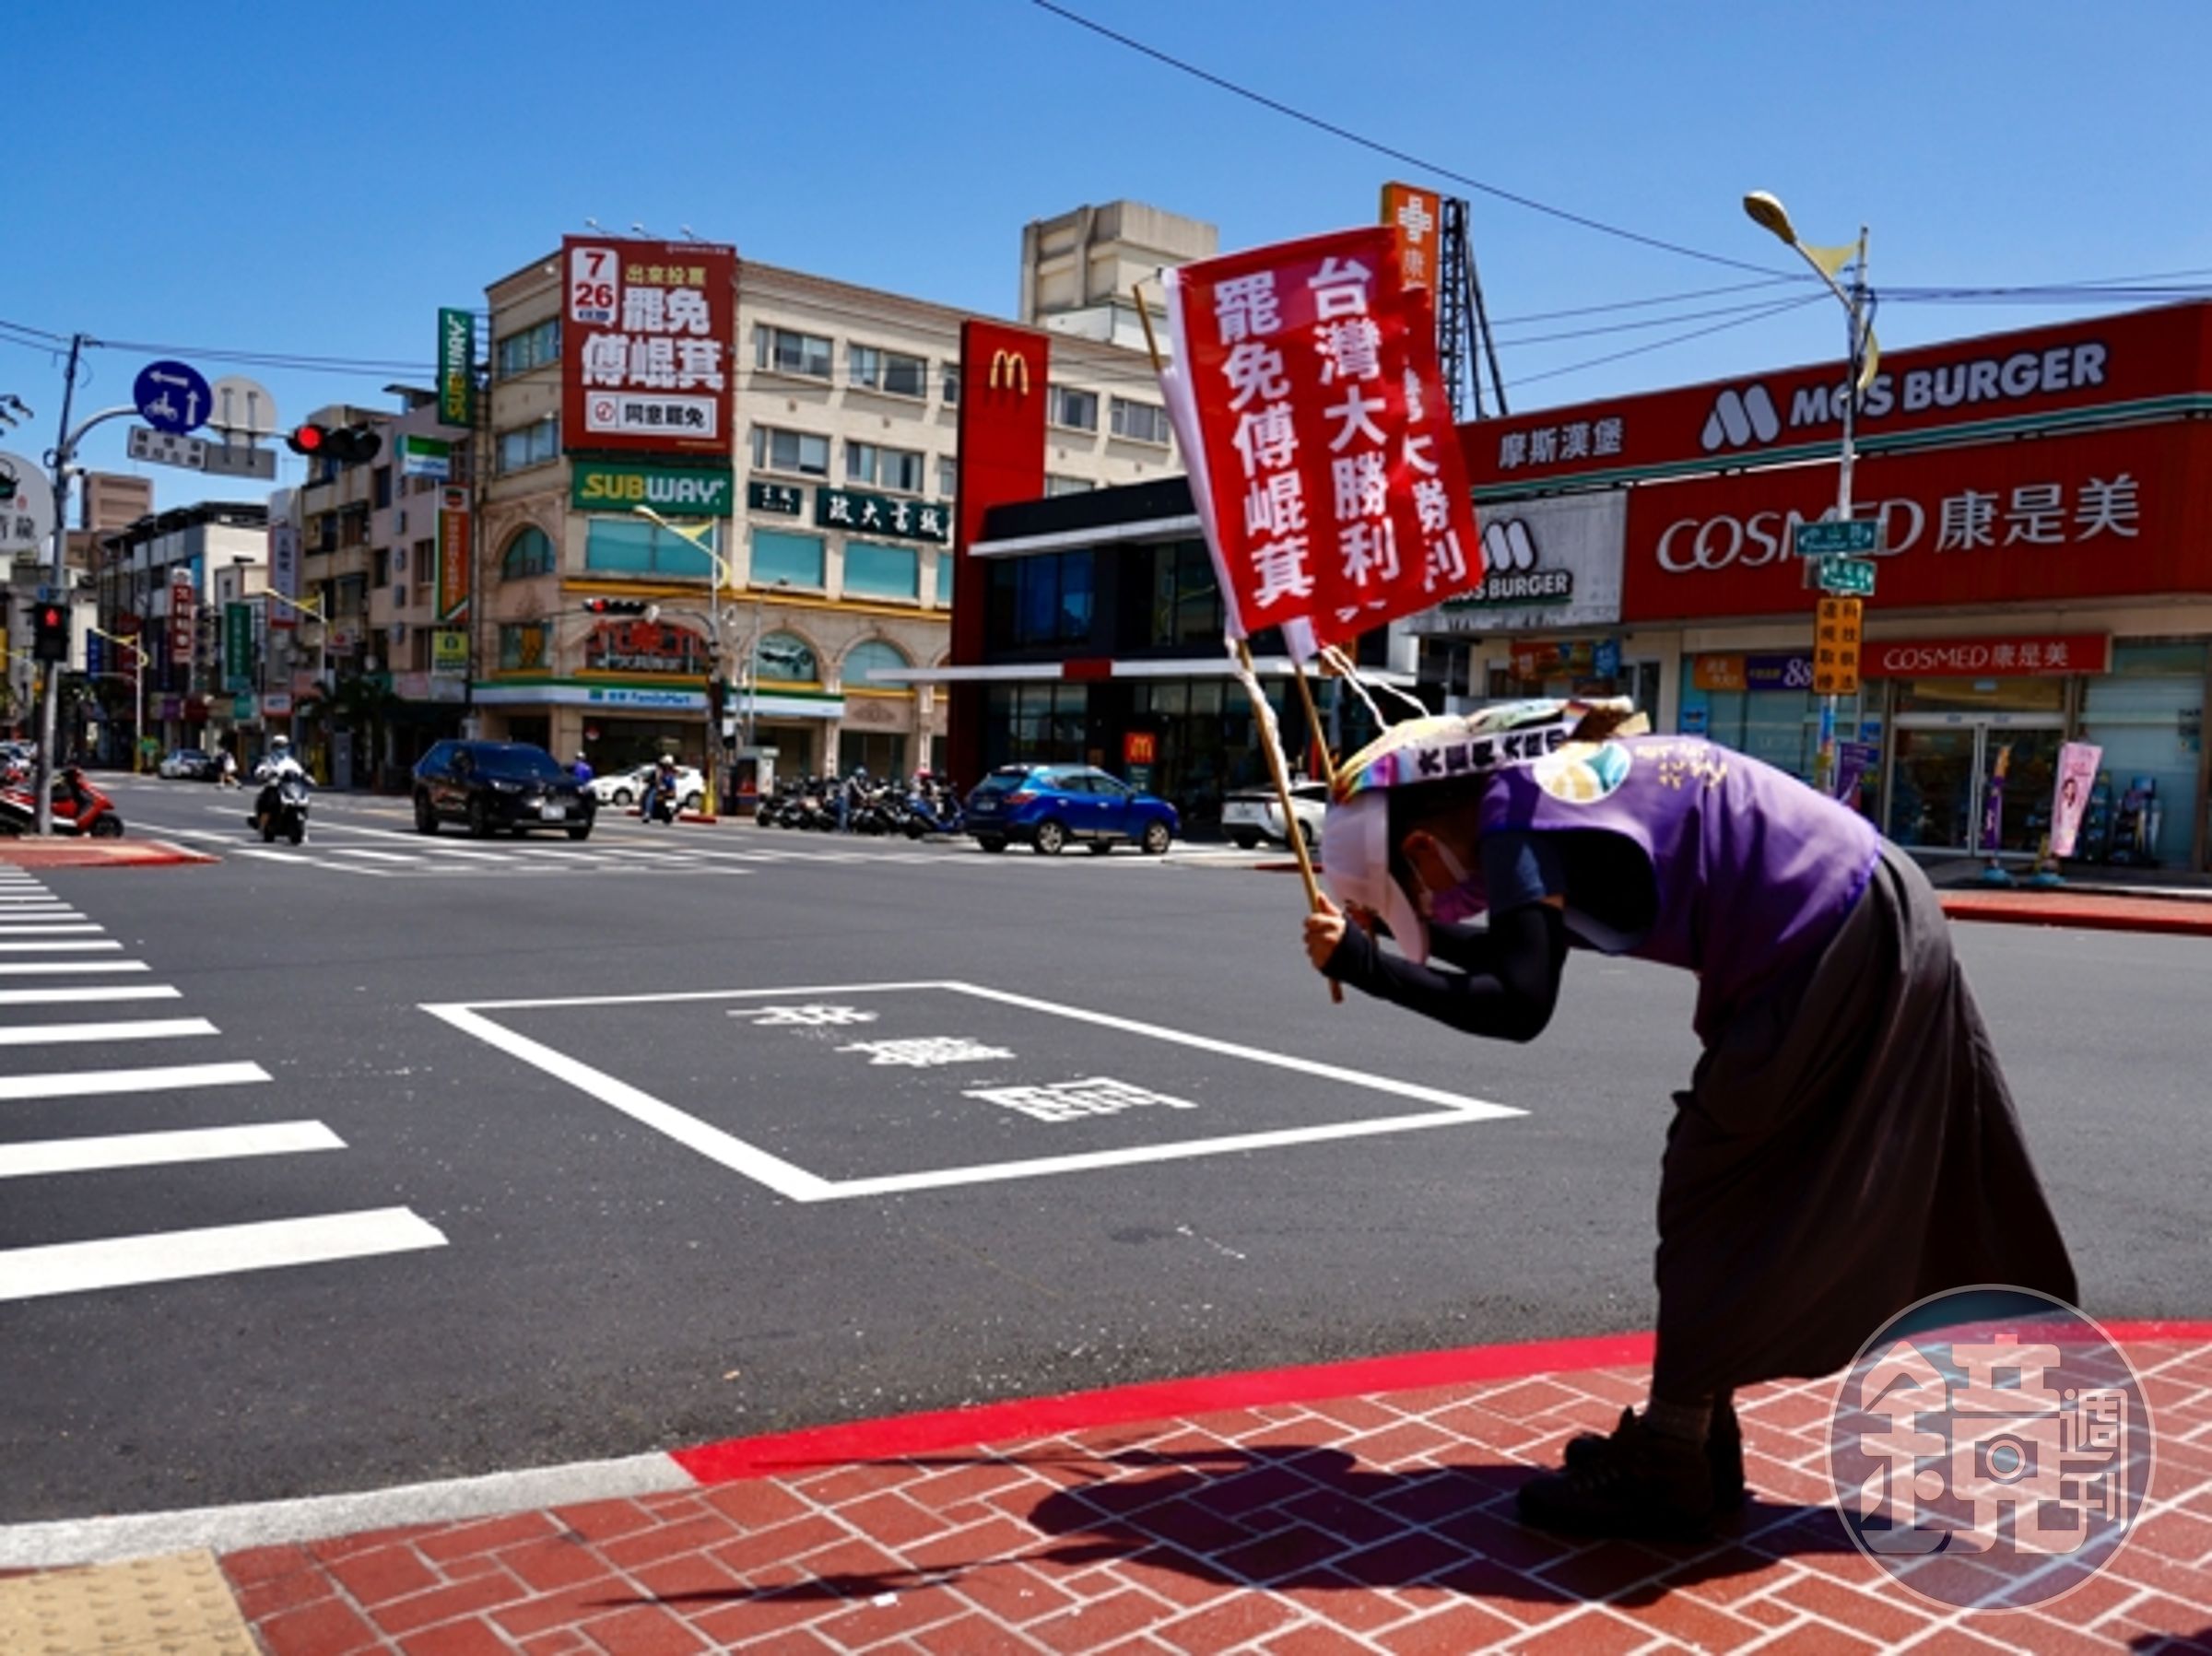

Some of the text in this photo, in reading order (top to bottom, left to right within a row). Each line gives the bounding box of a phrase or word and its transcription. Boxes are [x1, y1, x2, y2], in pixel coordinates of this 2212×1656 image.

[585, 252, 606, 278] 7
[625, 264, 707, 287] 出來投票
[575, 282, 614, 309] 26
[622, 287, 711, 335] 罷免
[448, 313, 466, 422] SUBWAY
[582, 332, 724, 392] 傅崐萁
[1903, 343, 2107, 411] BURGER
[624, 403, 705, 428] 同意罷免
[1213, 269, 1316, 609] 罷免傅崐萁
[1307, 256, 1401, 588] 台灣大勝利
[1499, 417, 1625, 469] 摩斯漢堡
[581, 473, 726, 505] SUBWAY
[1934, 471, 2140, 553] 康是美
[1488, 573, 1569, 597] BURGER
[1883, 642, 2069, 670] COSMED 康是美
